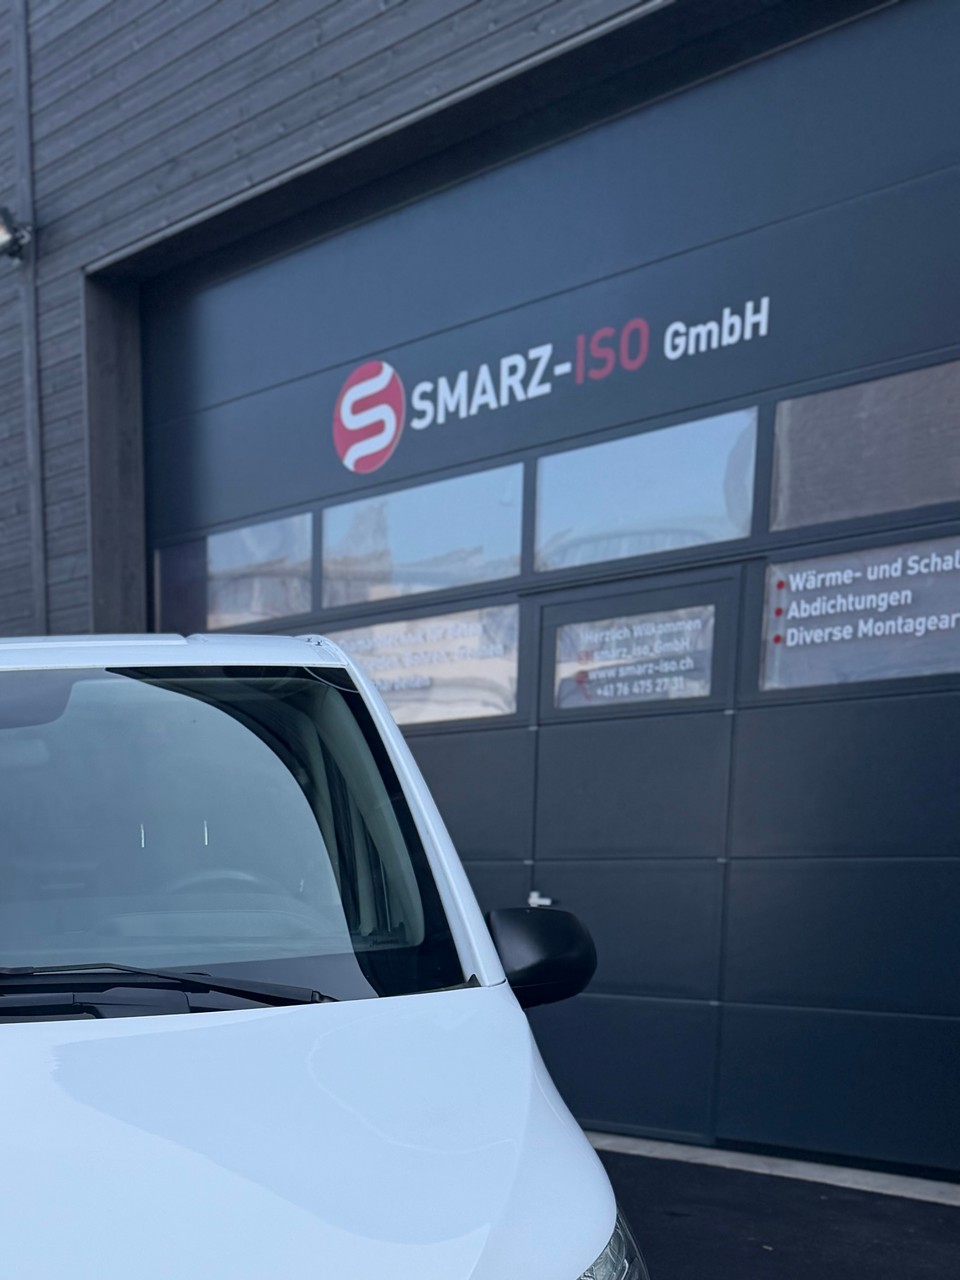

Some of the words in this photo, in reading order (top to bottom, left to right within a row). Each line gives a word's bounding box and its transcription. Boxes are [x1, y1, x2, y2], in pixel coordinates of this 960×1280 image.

[410, 318, 649, 429] SMARZ-ISO
[663, 297, 769, 360] GmbH
[788, 569, 862, 592] Wärme-
[867, 558, 902, 580] und
[787, 589, 912, 620] Abdichtungen
[581, 625, 632, 643] Herzlich
[786, 625, 853, 646] Diverse
[596, 683, 615, 697] +41
[616, 681, 630, 696] 76
